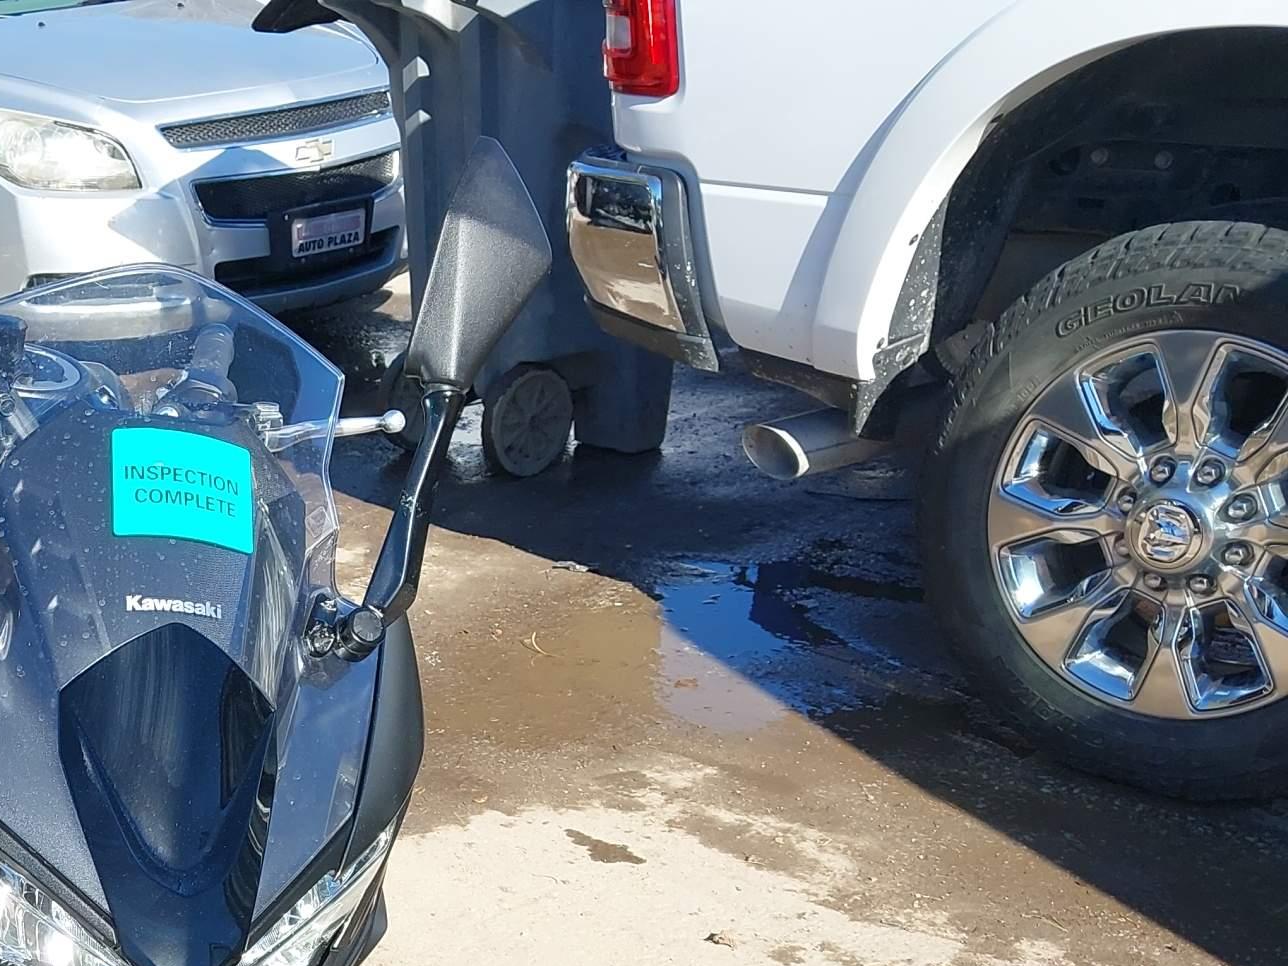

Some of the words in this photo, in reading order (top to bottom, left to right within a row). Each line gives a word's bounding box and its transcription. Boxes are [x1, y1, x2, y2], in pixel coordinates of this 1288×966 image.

[298, 238, 324, 254] AUTO
[327, 231, 361, 249] PLAZA
[123, 464, 239, 497] INSPECTION
[134, 487, 237, 518] COMPLETE
[125, 595, 223, 620] Kawasaki
